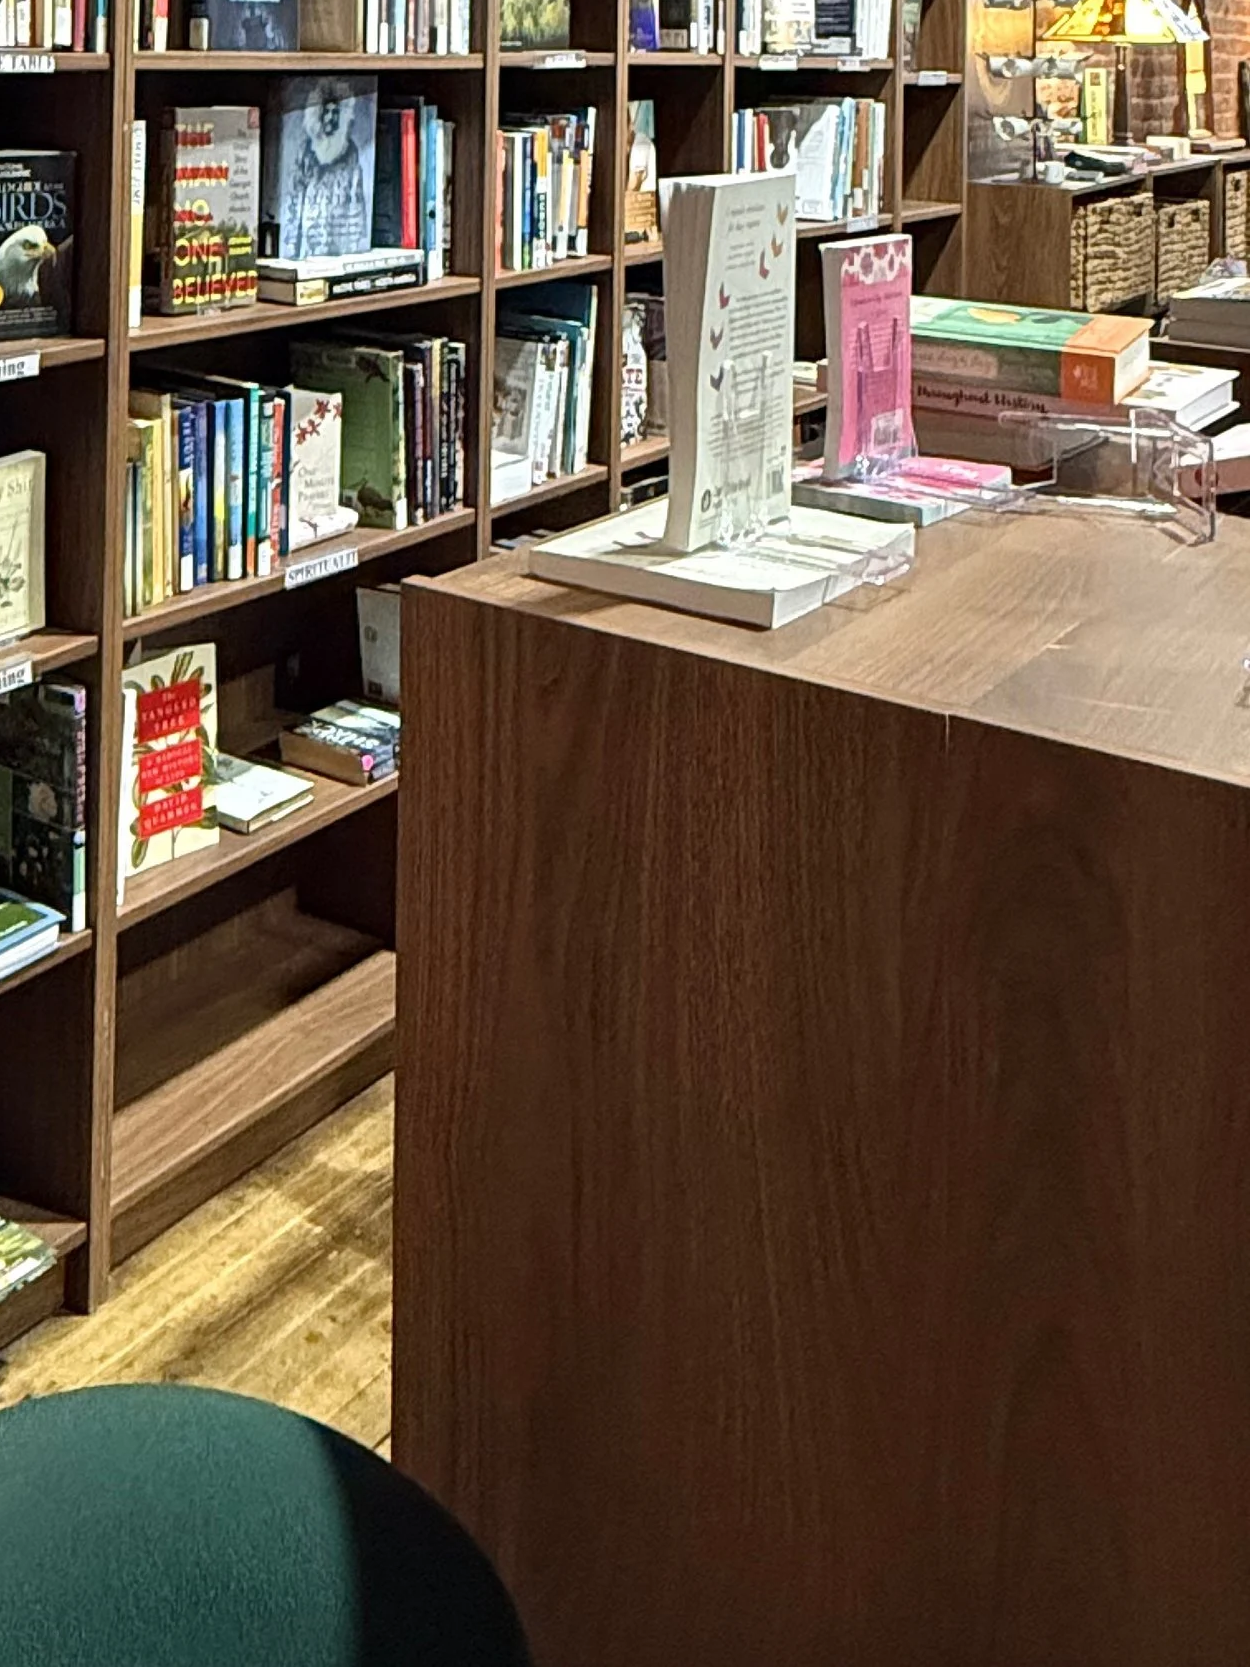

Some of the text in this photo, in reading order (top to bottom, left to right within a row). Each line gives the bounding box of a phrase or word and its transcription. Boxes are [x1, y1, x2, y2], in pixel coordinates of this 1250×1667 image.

[175, 123, 215, 149] THE
[174, 160, 230, 189] MAN
[173, 198, 212, 227] NO
[172, 234, 226, 267] ONE
[171, 270, 259, 306] BELIEVED
